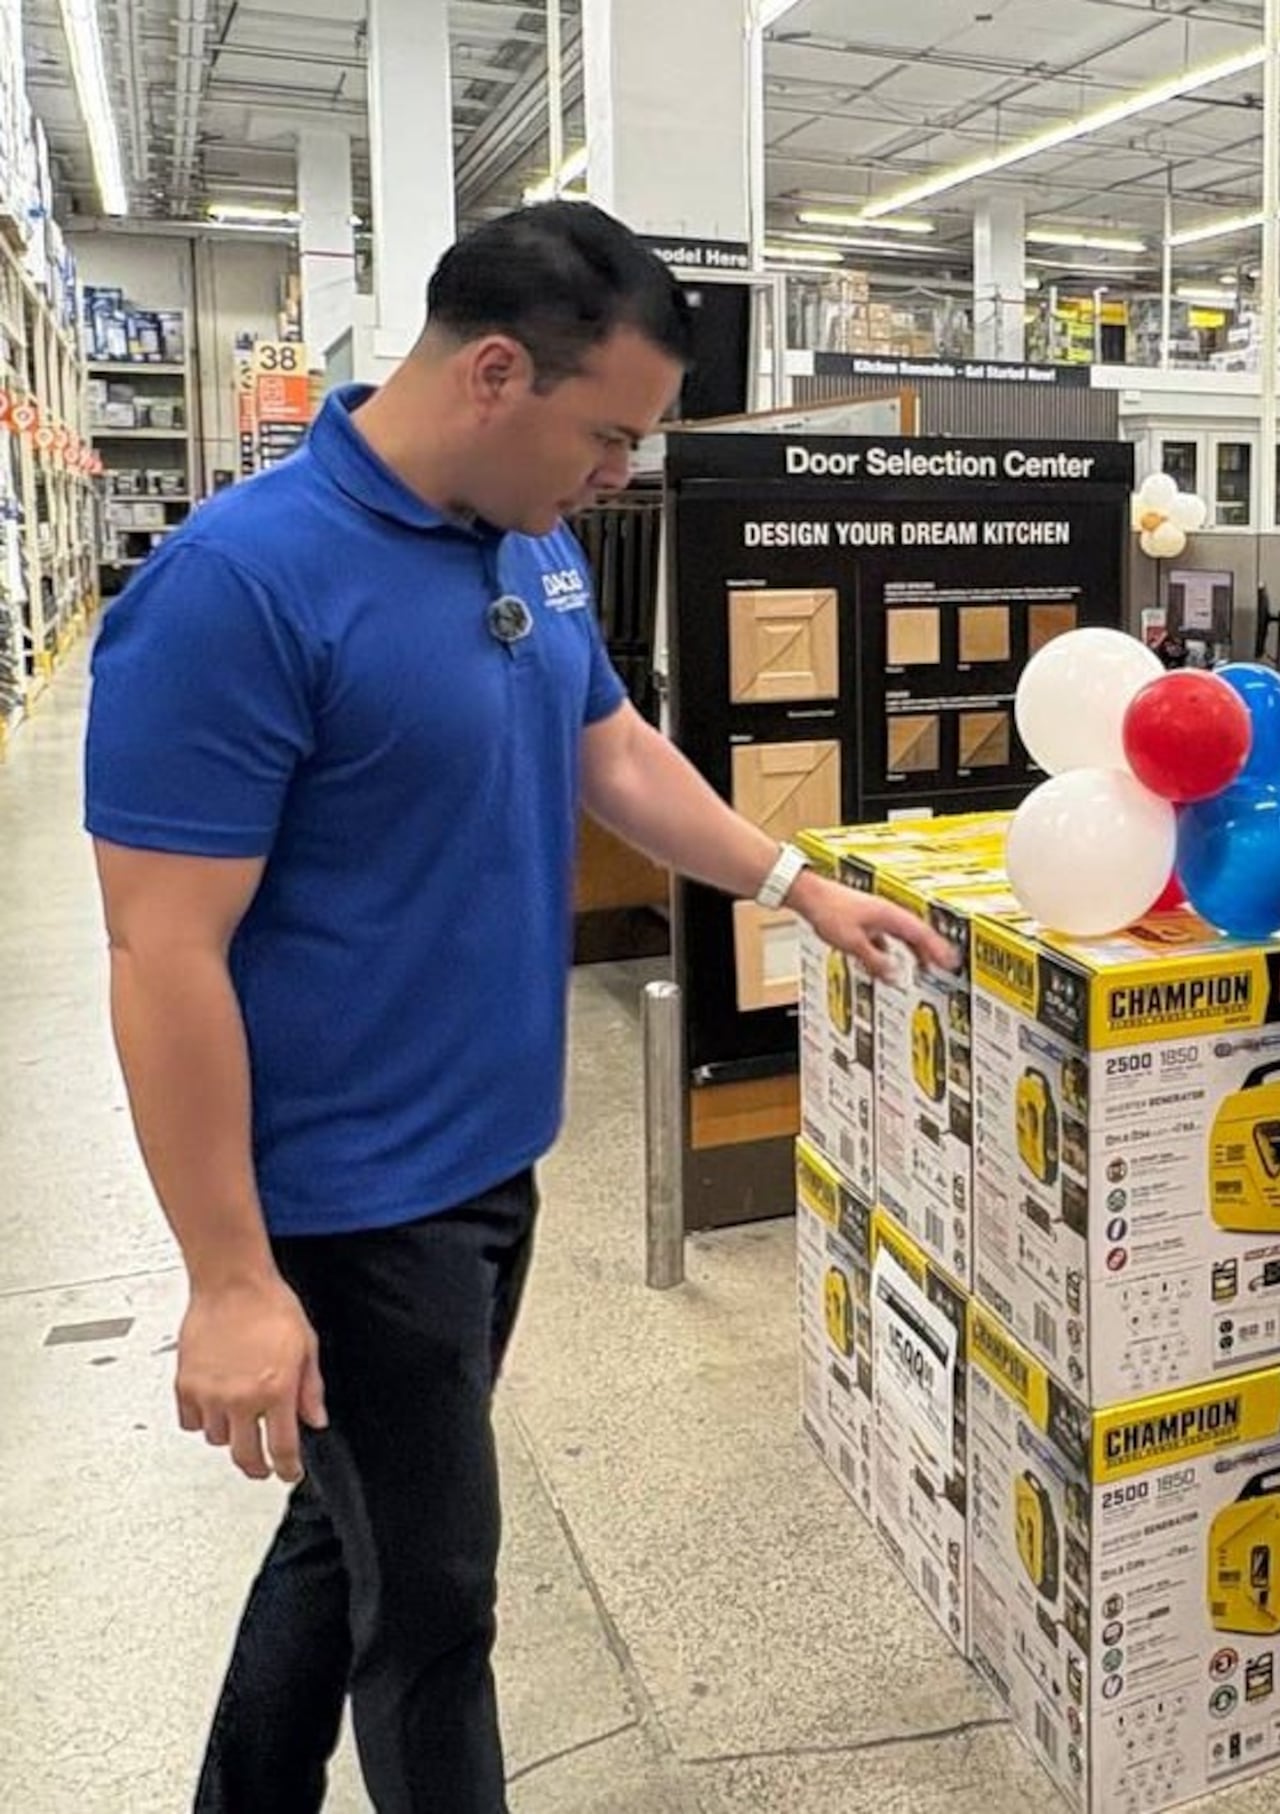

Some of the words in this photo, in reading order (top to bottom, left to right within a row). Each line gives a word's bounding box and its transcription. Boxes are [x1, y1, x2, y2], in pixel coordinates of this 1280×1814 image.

[706, 249, 747, 267] Here
[260, 345, 297, 371] 38
[786, 446, 859, 475] Door
[866, 448, 997, 477] Selection
[1003, 450, 1095, 478] Center
[744, 522, 829, 547] DESIGN
[835, 522, 895, 545] YOUR
[902, 521, 978, 545] DREAM
[983, 521, 1070, 544] KITCHEN
[1109, 973, 1251, 1021] CHAMPION
[1106, 1052, 1152, 1075] 2500
[1160, 1046, 1198, 1066] 1850
[1105, 1398, 1241, 1457] CHAMPION
[1102, 1481, 1149, 1510] 2500
[1156, 1467, 1196, 1493] 1850
